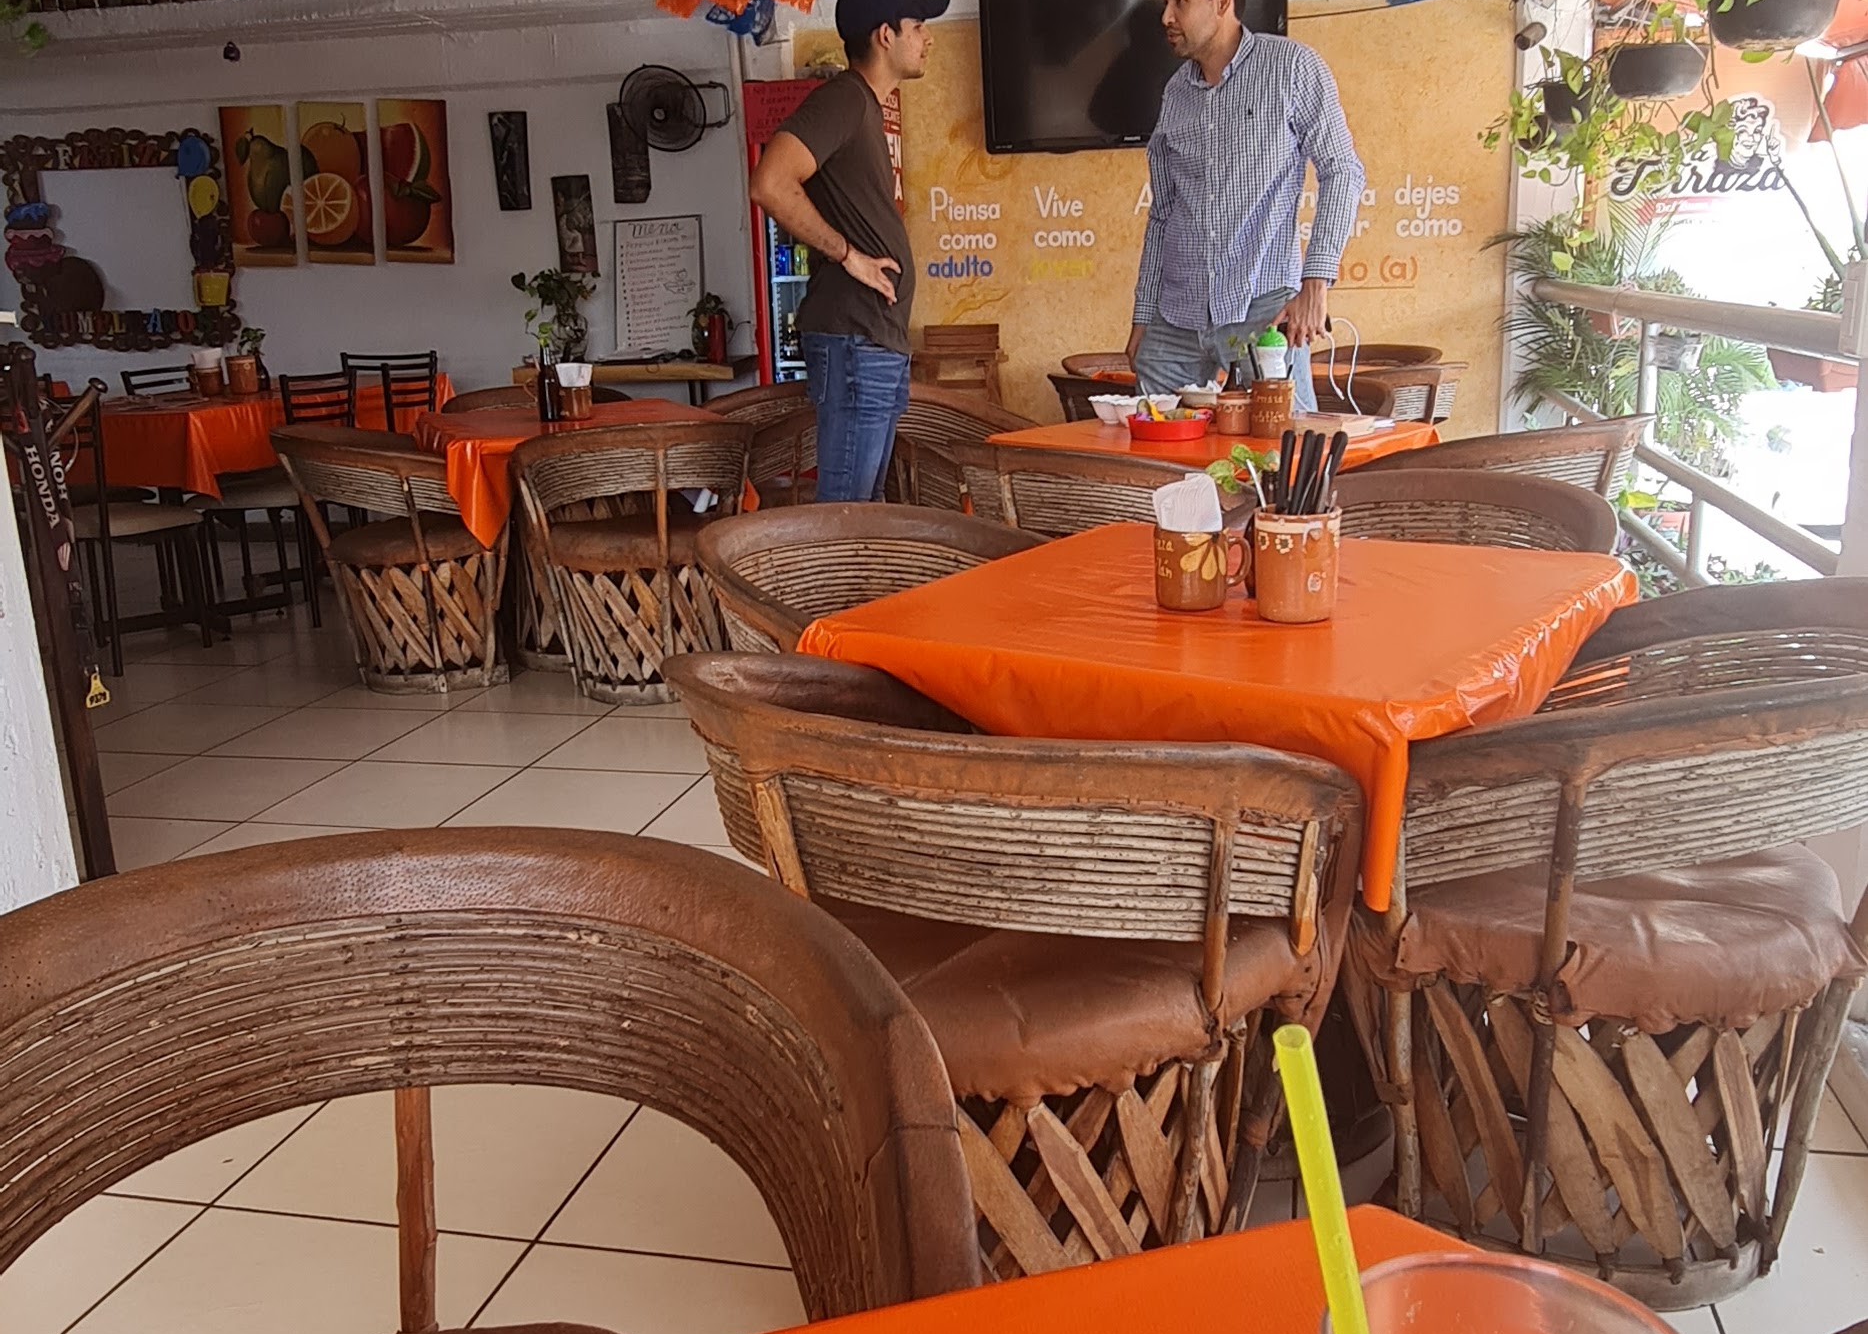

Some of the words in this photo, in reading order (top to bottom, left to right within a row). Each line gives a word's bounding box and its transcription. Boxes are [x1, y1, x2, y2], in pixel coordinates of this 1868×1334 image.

[930, 186, 1001, 222] Piensa
[1033, 185, 1084, 218] Vive
[1394, 174, 1460, 218] dejes
[939, 232, 997, 250] como
[1034, 229, 1095, 247] como
[1396, 218, 1462, 238] como
[927, 255, 993, 278] adulto
[1379, 255, 1418, 283] (a)
[24, 444, 61, 530] HONDA
